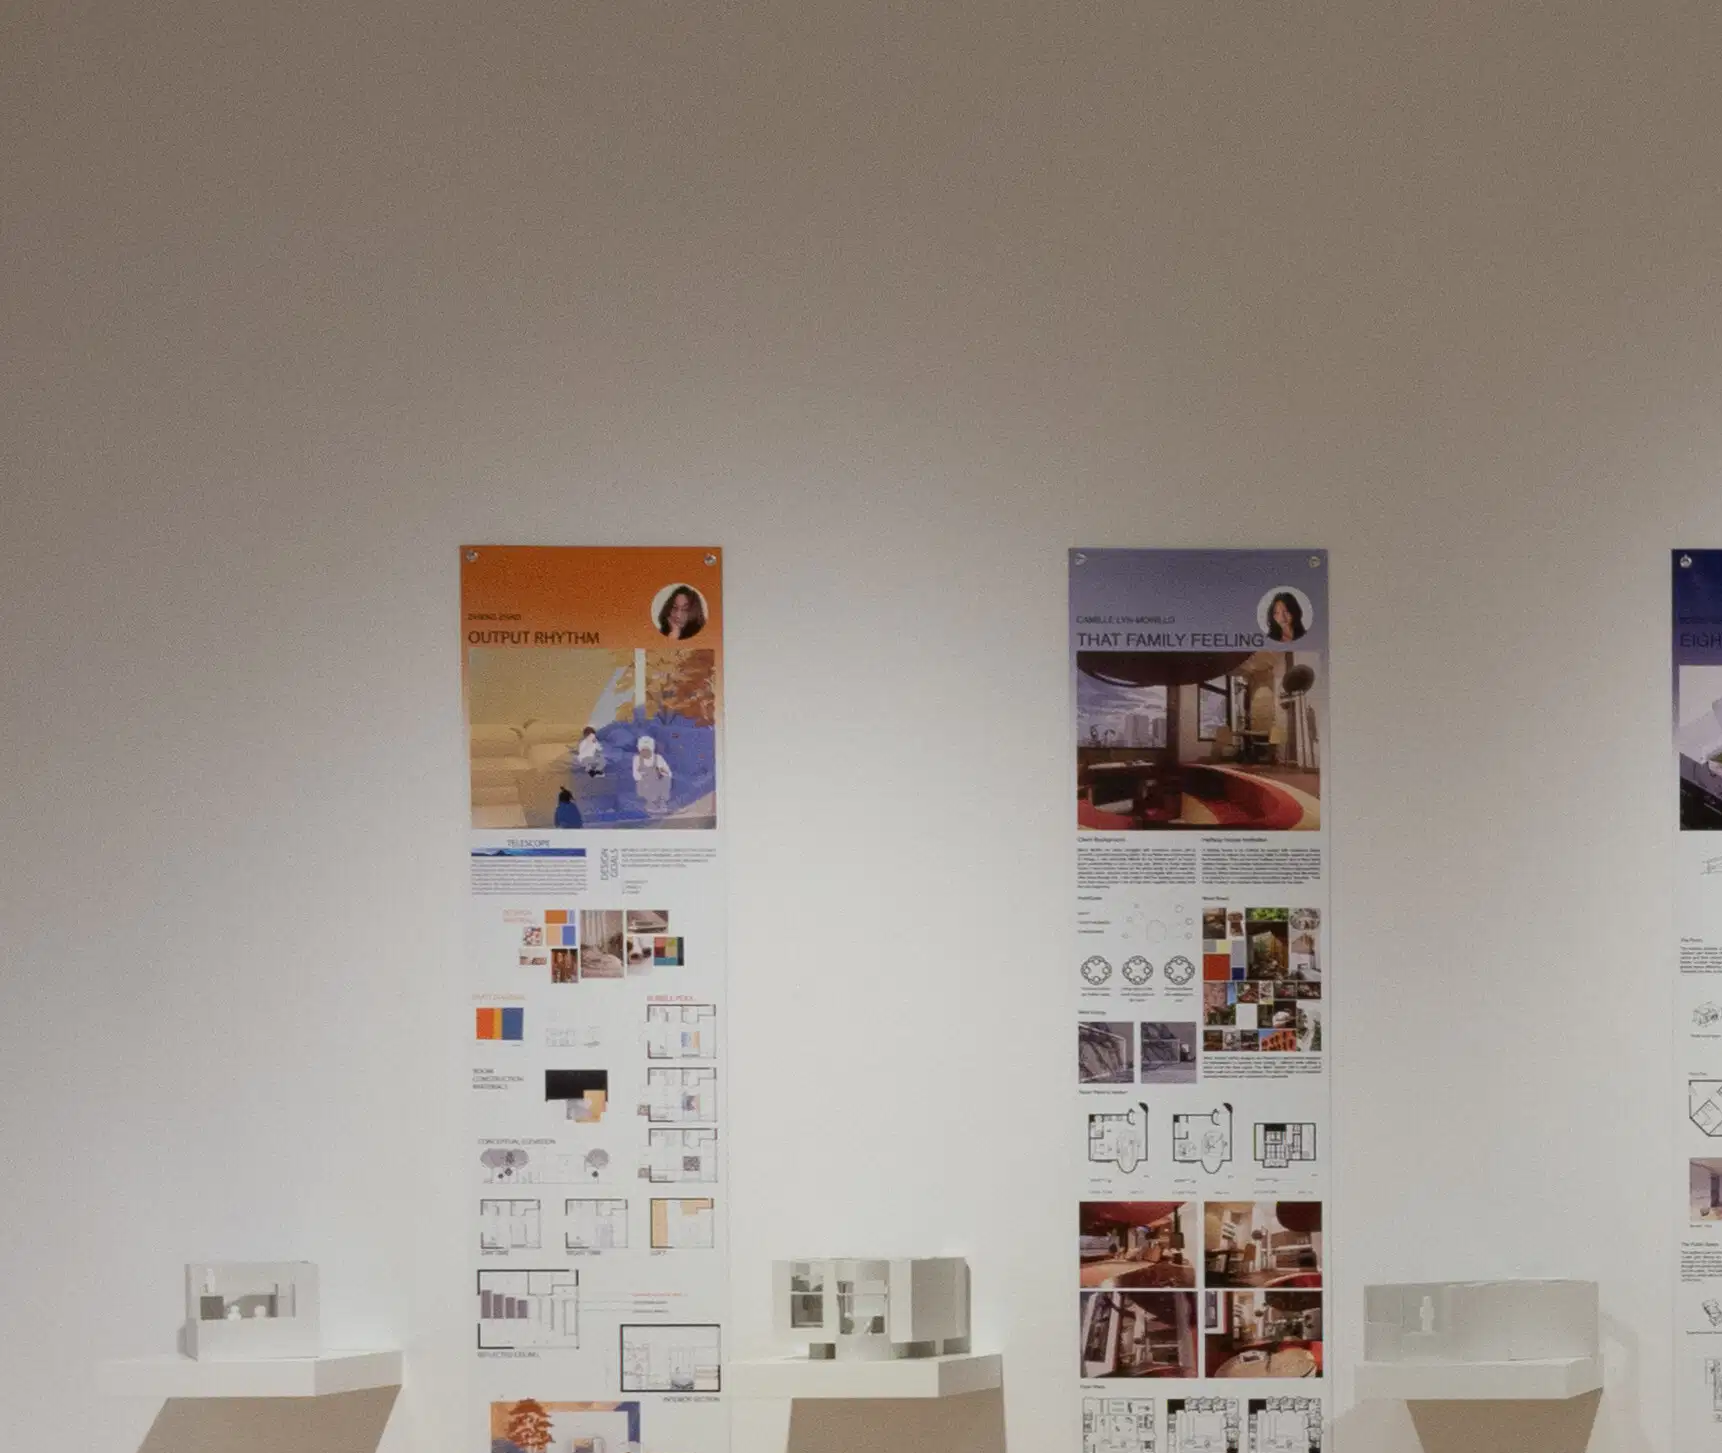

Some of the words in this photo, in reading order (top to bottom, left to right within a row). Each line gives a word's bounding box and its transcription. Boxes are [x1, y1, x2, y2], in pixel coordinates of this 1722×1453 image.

[468, 630, 530, 644] OUTPUT
[534, 630, 600, 645] RHYTHM
[1077, 632, 1121, 647] THAT
[1127, 632, 1186, 647] FAMILY
[1191, 632, 1265, 647] FEELING
